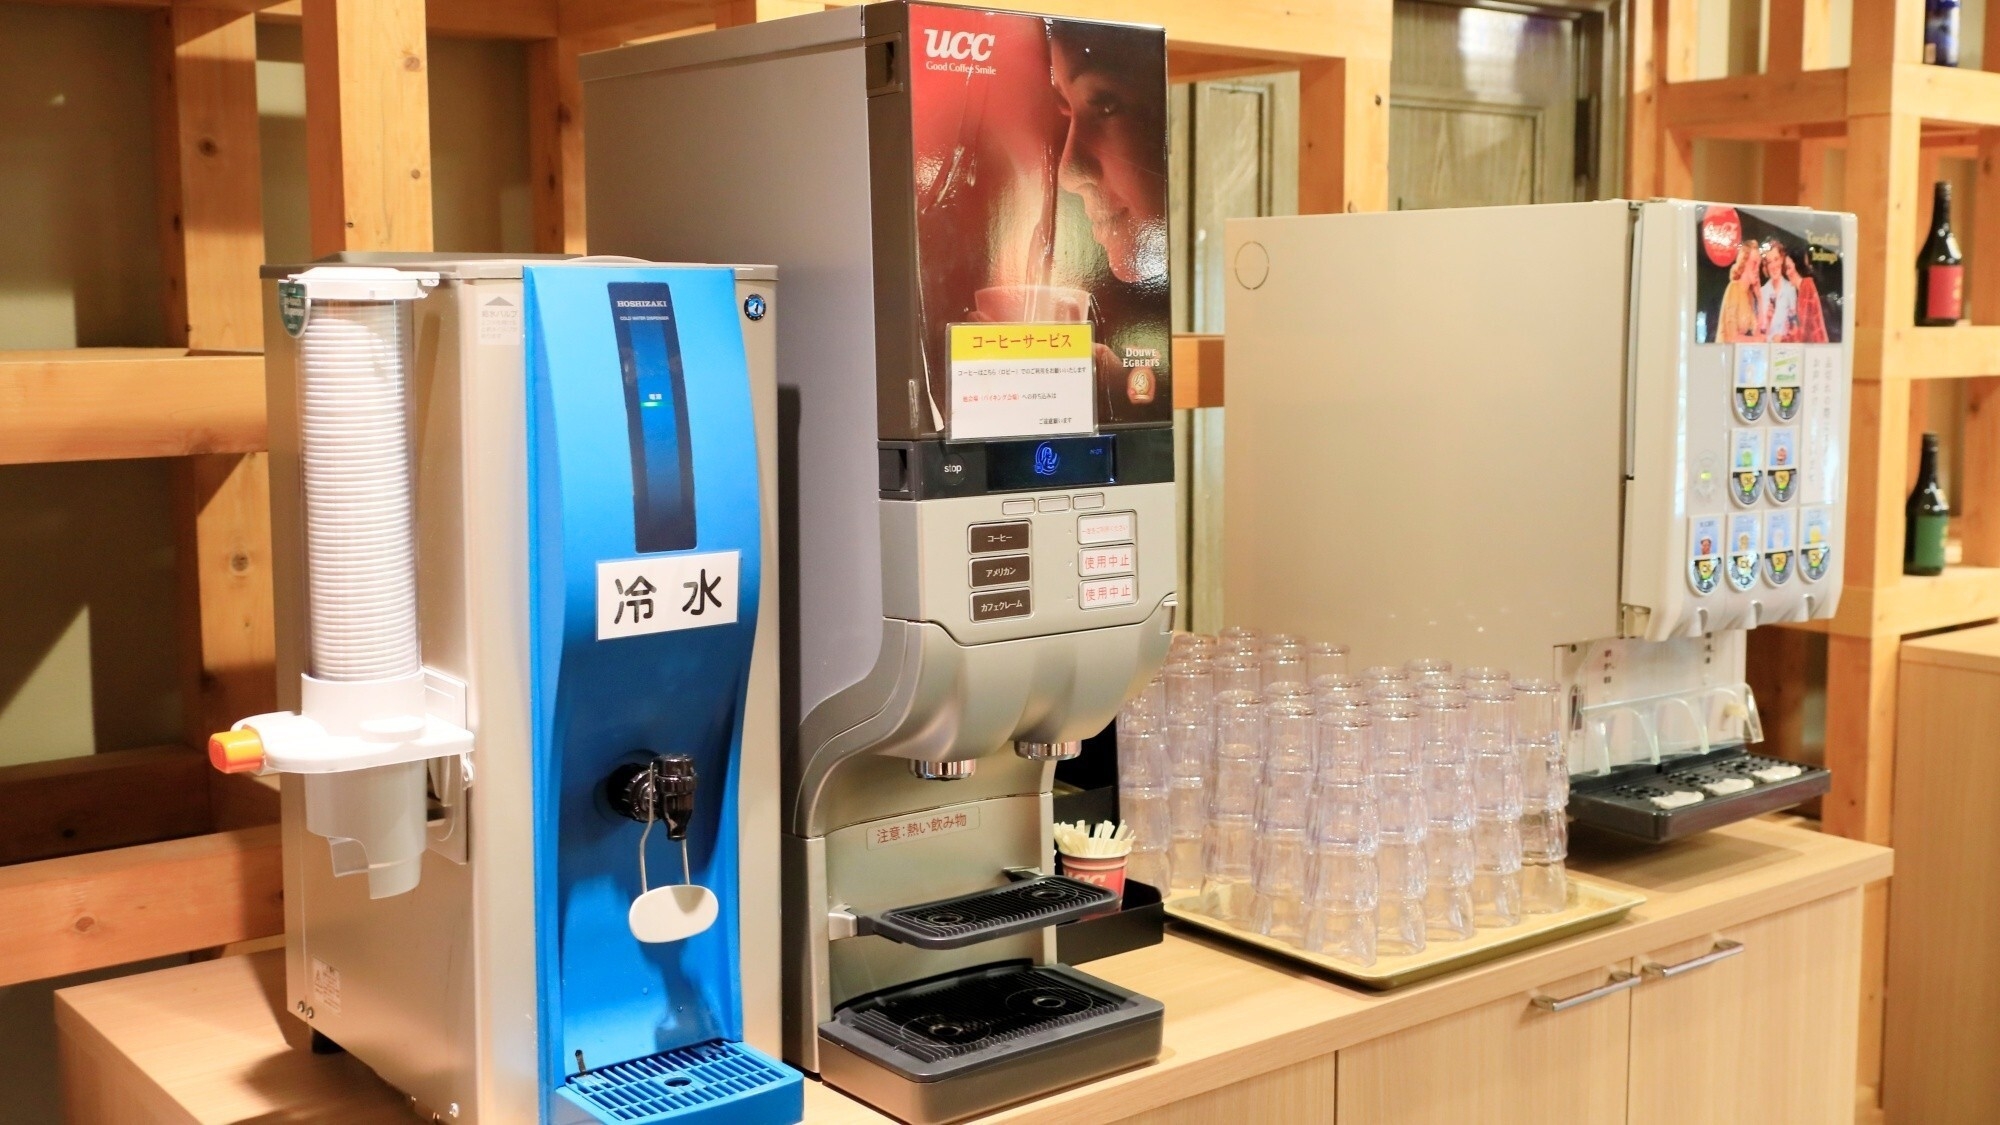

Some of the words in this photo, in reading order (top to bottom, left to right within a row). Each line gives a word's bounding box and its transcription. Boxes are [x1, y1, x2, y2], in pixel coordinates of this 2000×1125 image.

[925, 60, 948, 72] Good
[949, 62, 974, 74] Coffee
[975, 64, 997, 75] Smile
[616, 300, 668, 309] HOSHIZAKI
[972, 333, 1073, 349] コーヒーサービス
[1125, 347, 1157, 358] DOUWE
[1122, 357, 1161, 368] EGBERTS
[944, 463, 963, 474] stop
[987, 534, 1013, 543] コーヒー
[1084, 554, 1130, 570] 使用中止
[985, 567, 1017, 578] アメリカン
[1085, 586, 1131, 602] 使用中止
[981, 599, 1023, 613] カフェクレーム
